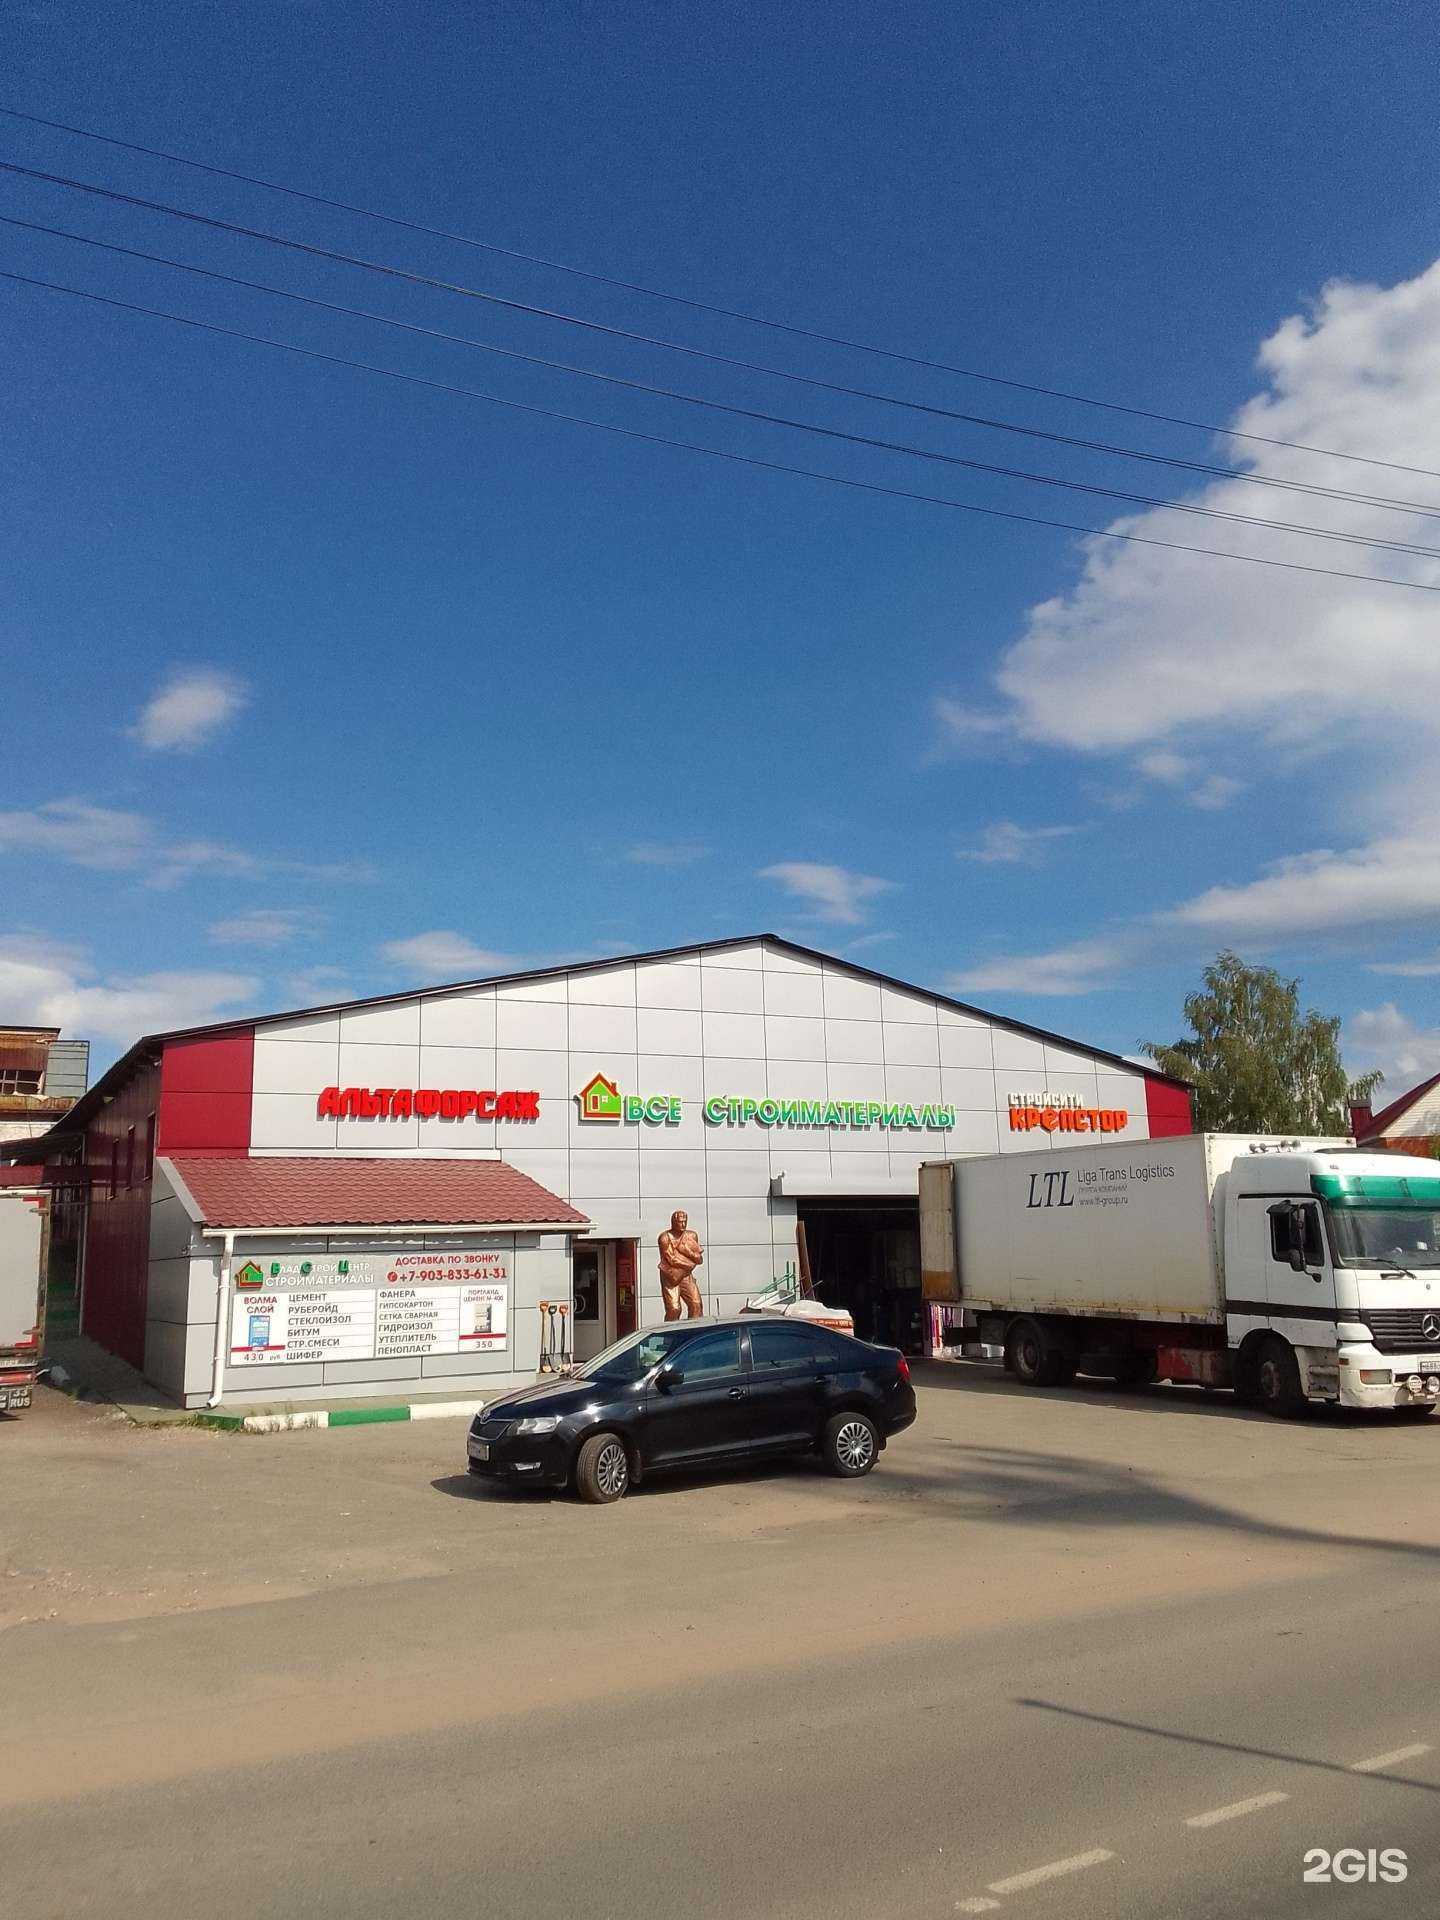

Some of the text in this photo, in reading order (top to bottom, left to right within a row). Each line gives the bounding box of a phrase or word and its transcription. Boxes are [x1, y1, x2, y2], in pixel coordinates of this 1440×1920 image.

[625, 1095, 683, 1122] ВСЕ
[1077, 1164, 1175, 1185] Liga Trans Logistics
[1026, 1171, 1075, 1208] LTL
[395, 1254, 500, 1267] ДОСТАВКА ПО ЗВОНКУ
[400, 1268, 507, 1282] +7-903-833-61-31
[288, 1293, 327, 1302] ЦЕМЕНТ
[379, 1290, 416, 1298] ФАНЕРА
[243, 1296, 278, 1305] ВОЛМА
[379, 1301, 434, 1310] ГИПСОКАРТОН
[246, 1305, 274, 1314] СЛОЙ
[288, 1303, 339, 1315] РУБЕРОЙД
[288, 1315, 352, 1326] СТЕКЛОИЗОЛ
[379, 1311, 439, 1321] СЕТКА СВАРНАЯ
[287, 1328, 320, 1337] БИТУМ
[378, 1322, 433, 1333] ГИДРОИЗОЛ
[287, 1338, 340, 1349] СТР.СМЕСИ
[379, 1333, 437, 1344] УТЕПЛИТЕЛЬ
[378, 1344, 432, 1355] ПЕНОПЛАСТ
[244, 1353, 264, 1361] 430
[286, 1351, 323, 1361] ШИФЕР
[10, 1397, 31, 1408] RUS
